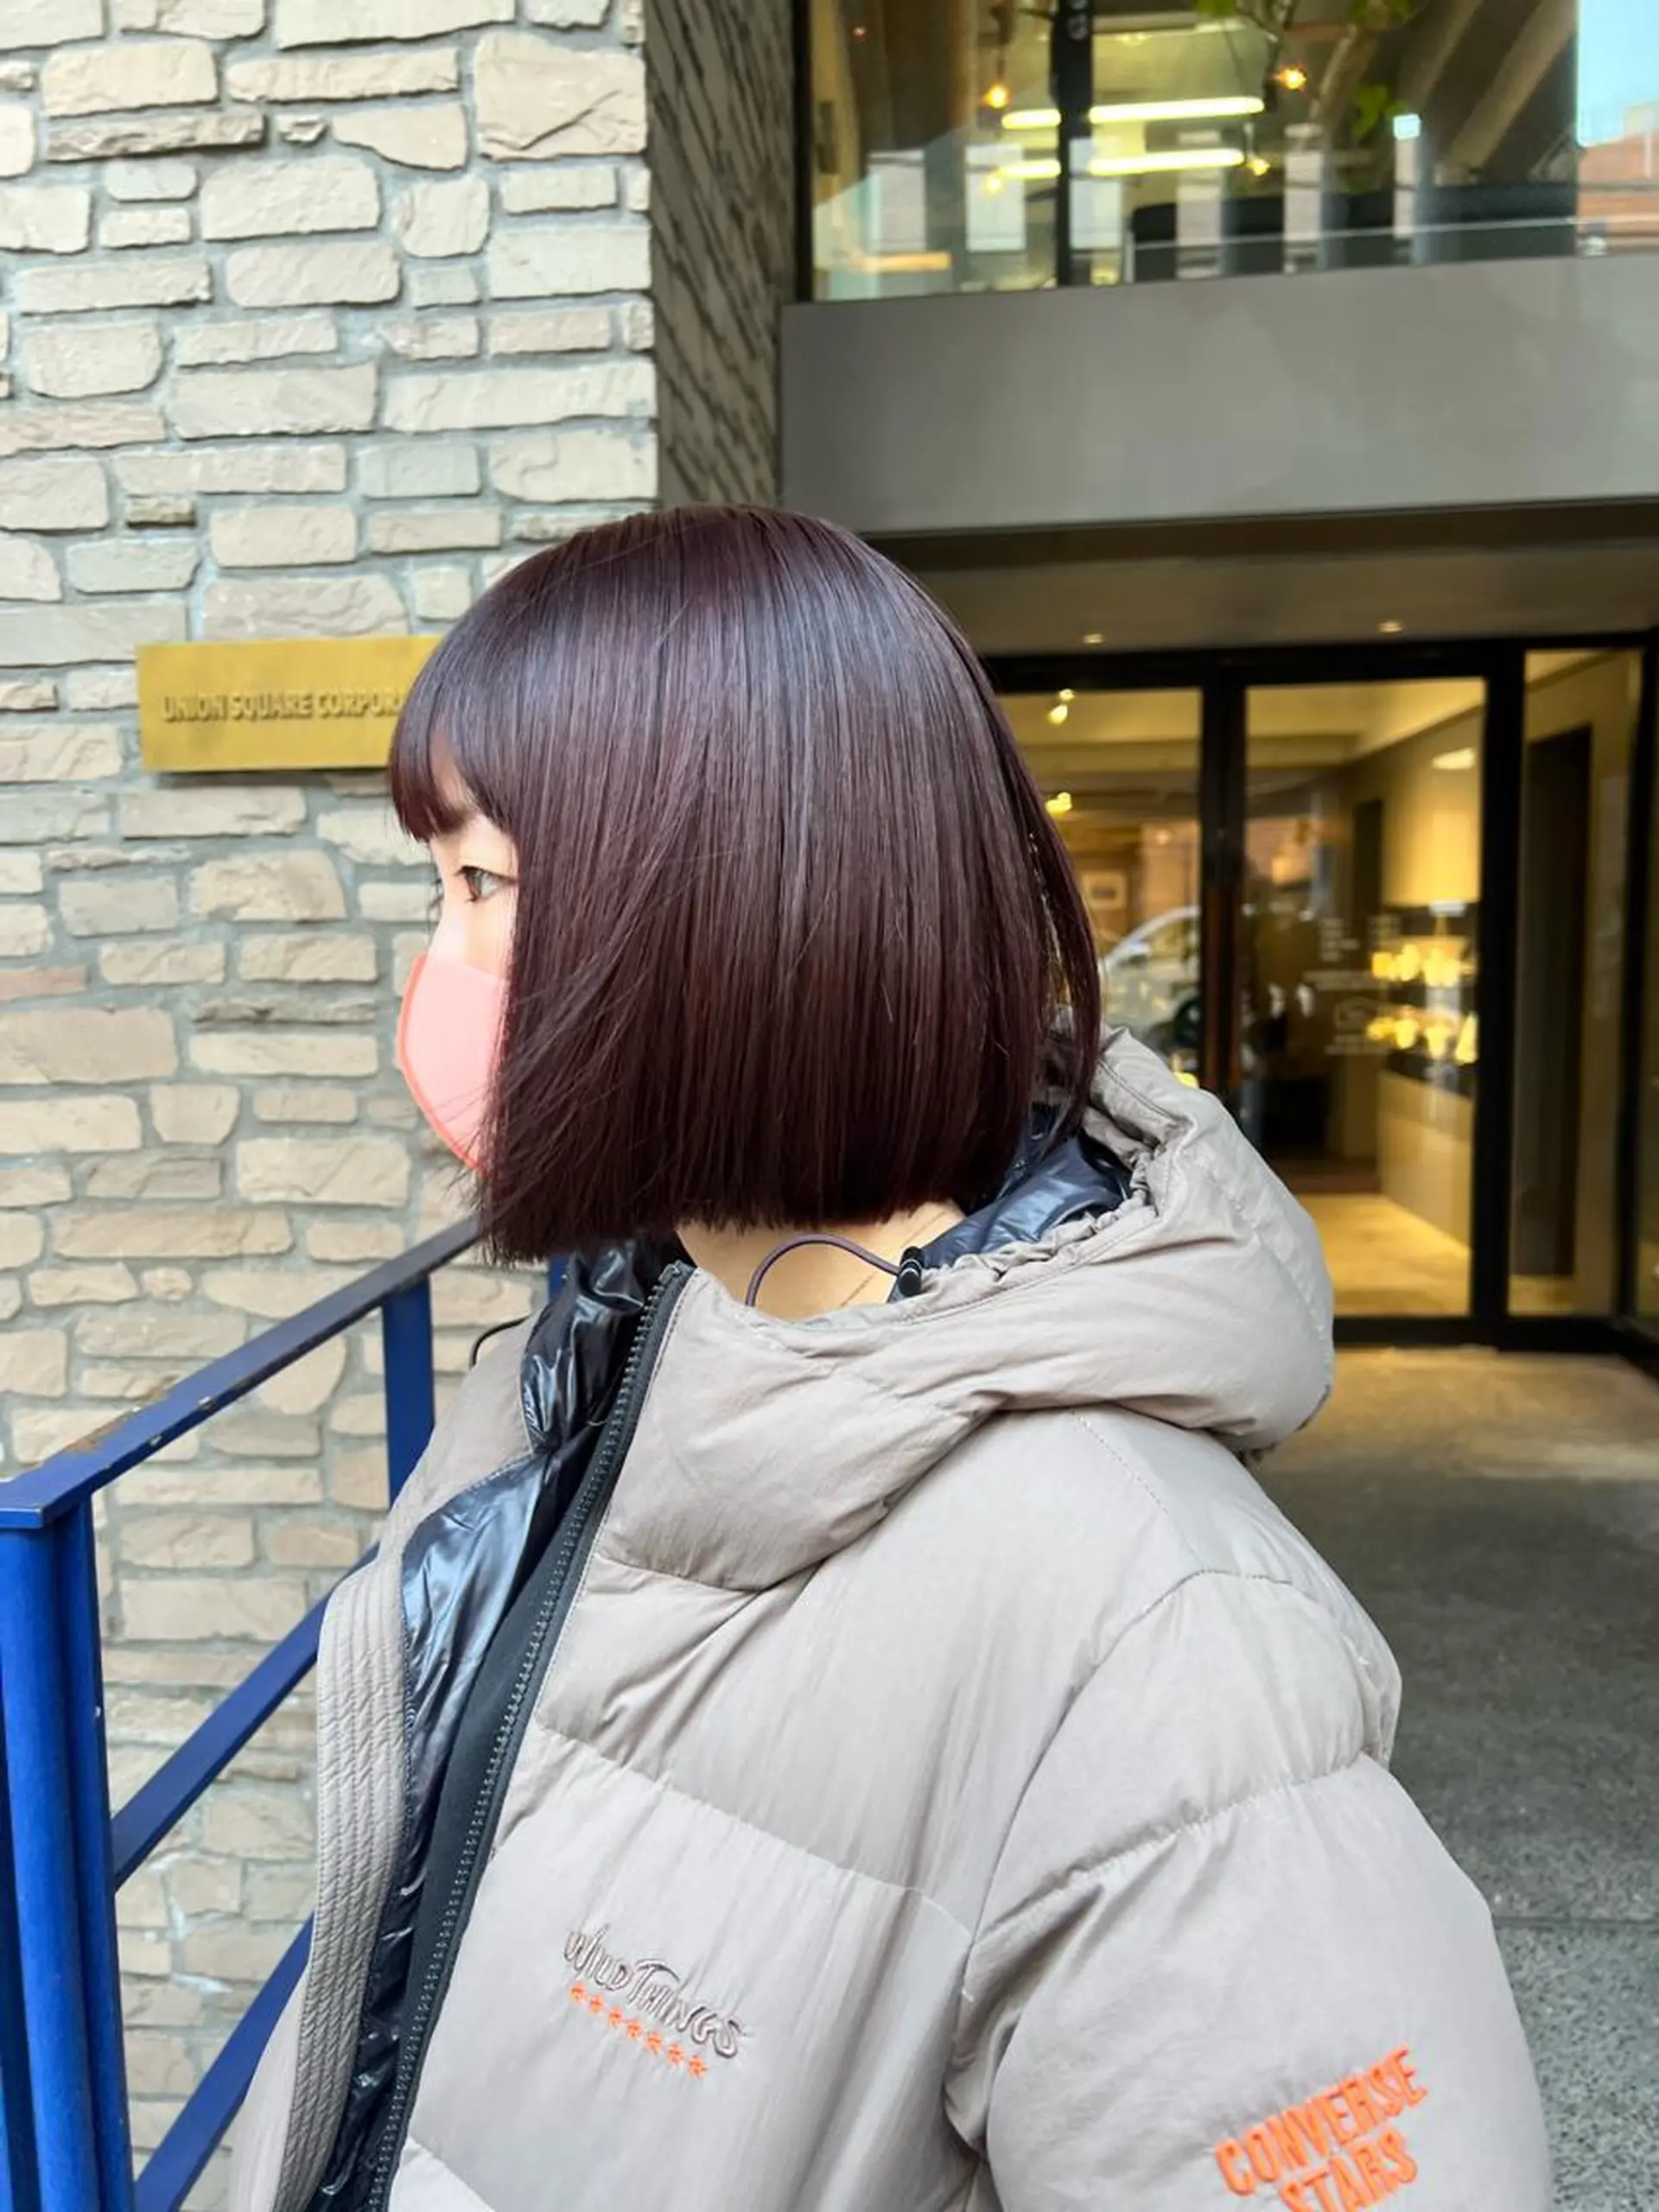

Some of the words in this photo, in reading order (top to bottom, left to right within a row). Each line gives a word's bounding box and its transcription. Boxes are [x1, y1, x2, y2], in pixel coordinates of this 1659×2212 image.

[163, 693, 227, 722] UNION
[230, 691, 313, 723] SQUARE
[563, 1924, 633, 1991] WILD
[626, 1957, 744, 2059] THINGS
[1215, 2045, 1427, 2196] CONVERSE
[1280, 2126, 1418, 2212] STARS
